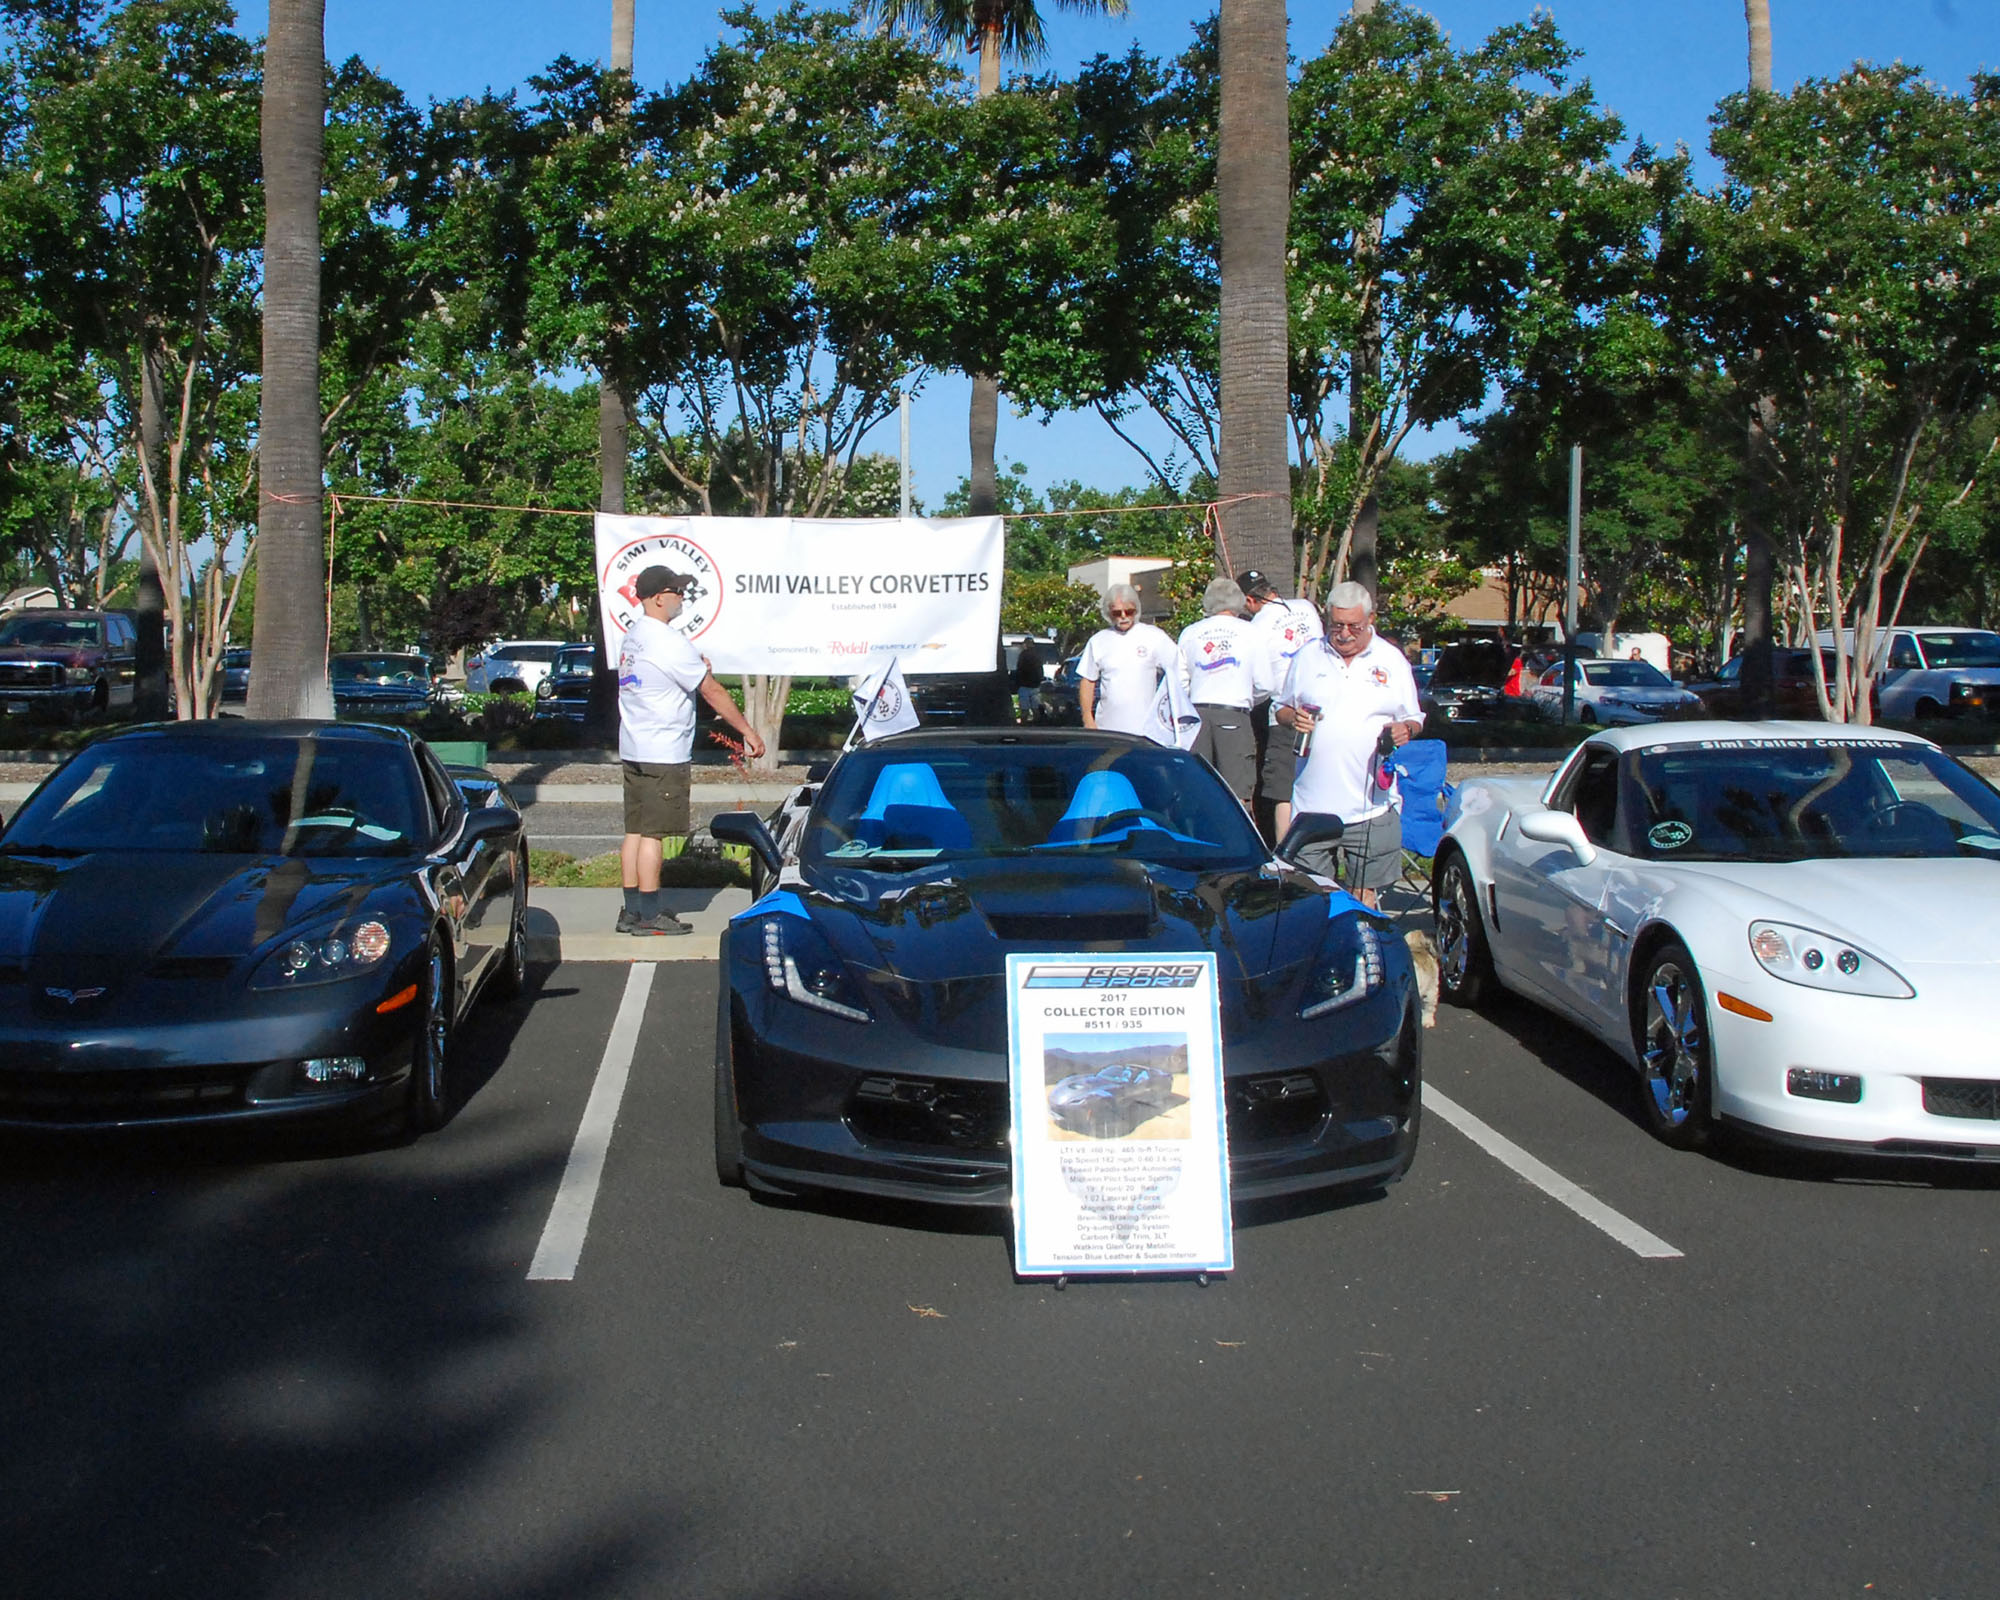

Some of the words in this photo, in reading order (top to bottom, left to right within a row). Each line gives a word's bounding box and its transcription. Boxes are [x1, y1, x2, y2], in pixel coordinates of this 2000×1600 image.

[617, 544, 647, 571] SIMI
[658, 539, 711, 573] VALLEY
[735, 574, 780, 594] SIMI
[785, 575, 864, 594] VALLEY
[869, 572, 989, 594] CORVETTES
[831, 602, 876, 610] Established
[767, 645, 806, 655] Sponsored
[828, 640, 868, 655] Rydell
[1700, 740, 1744, 749] Simi
[1750, 740, 1807, 749] Valley
[1814, 739, 1902, 749] Corvettes
[1091, 967, 1200, 977] GRAND
[1086, 976, 1194, 987] SPORT
[1100, 993, 1127, 1002] 2017
[1044, 1007, 1125, 1017] COLLECTOR
[1130, 1006, 1185, 1016] EDITION
[1085, 1020, 1111, 1029] #511
[1122, 1020, 1143, 1028] 935
[1125, 1242, 1144, 1251] Gray
[1104, 1252, 1133, 1260] Leather
